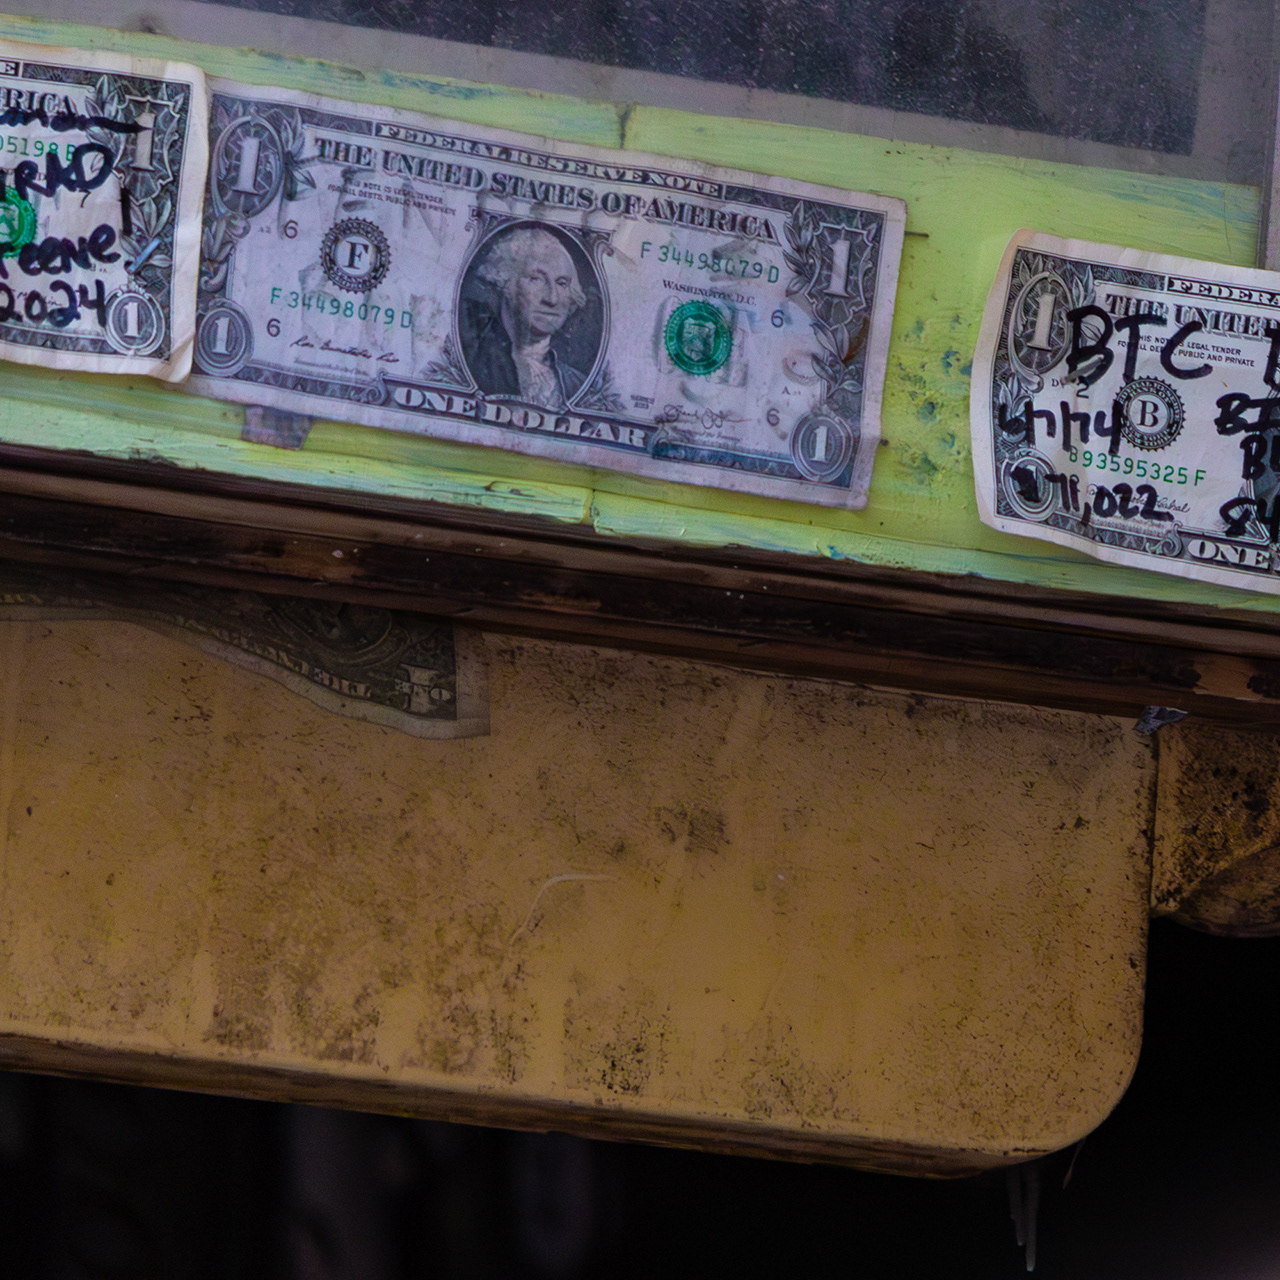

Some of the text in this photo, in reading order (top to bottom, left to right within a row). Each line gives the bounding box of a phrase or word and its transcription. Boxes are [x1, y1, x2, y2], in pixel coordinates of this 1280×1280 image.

[0, 88, 76, 114] RICA
[380, 123, 722, 198] FEDERAL RESERVE NOTE
[78, 189, 91, 209] 7
[314, 138, 376, 170] THE
[379, 149, 489, 192] UNITED
[490, 171, 598, 210] STATES
[600, 191, 644, 220] OF
[643, 199, 780, 244] AMERICA
[283, 220, 300, 241] 6
[344, 239, 371, 271] F
[270, 287, 785, 329] F34498079D 6
[266, 318, 281, 338] 6
[1066, 304, 1214, 383] BTC
[1187, 341, 1243, 357] LEGAL TENDER
[1178, 350, 1256, 369] PUBLIC AND PRIVATE
[394, 386, 647, 448] ONE DOLLAR
[1139, 398, 1160, 426] B
[1068, 449, 1208, 487] B93595325F
[1187, 539, 1271, 569] ONE
